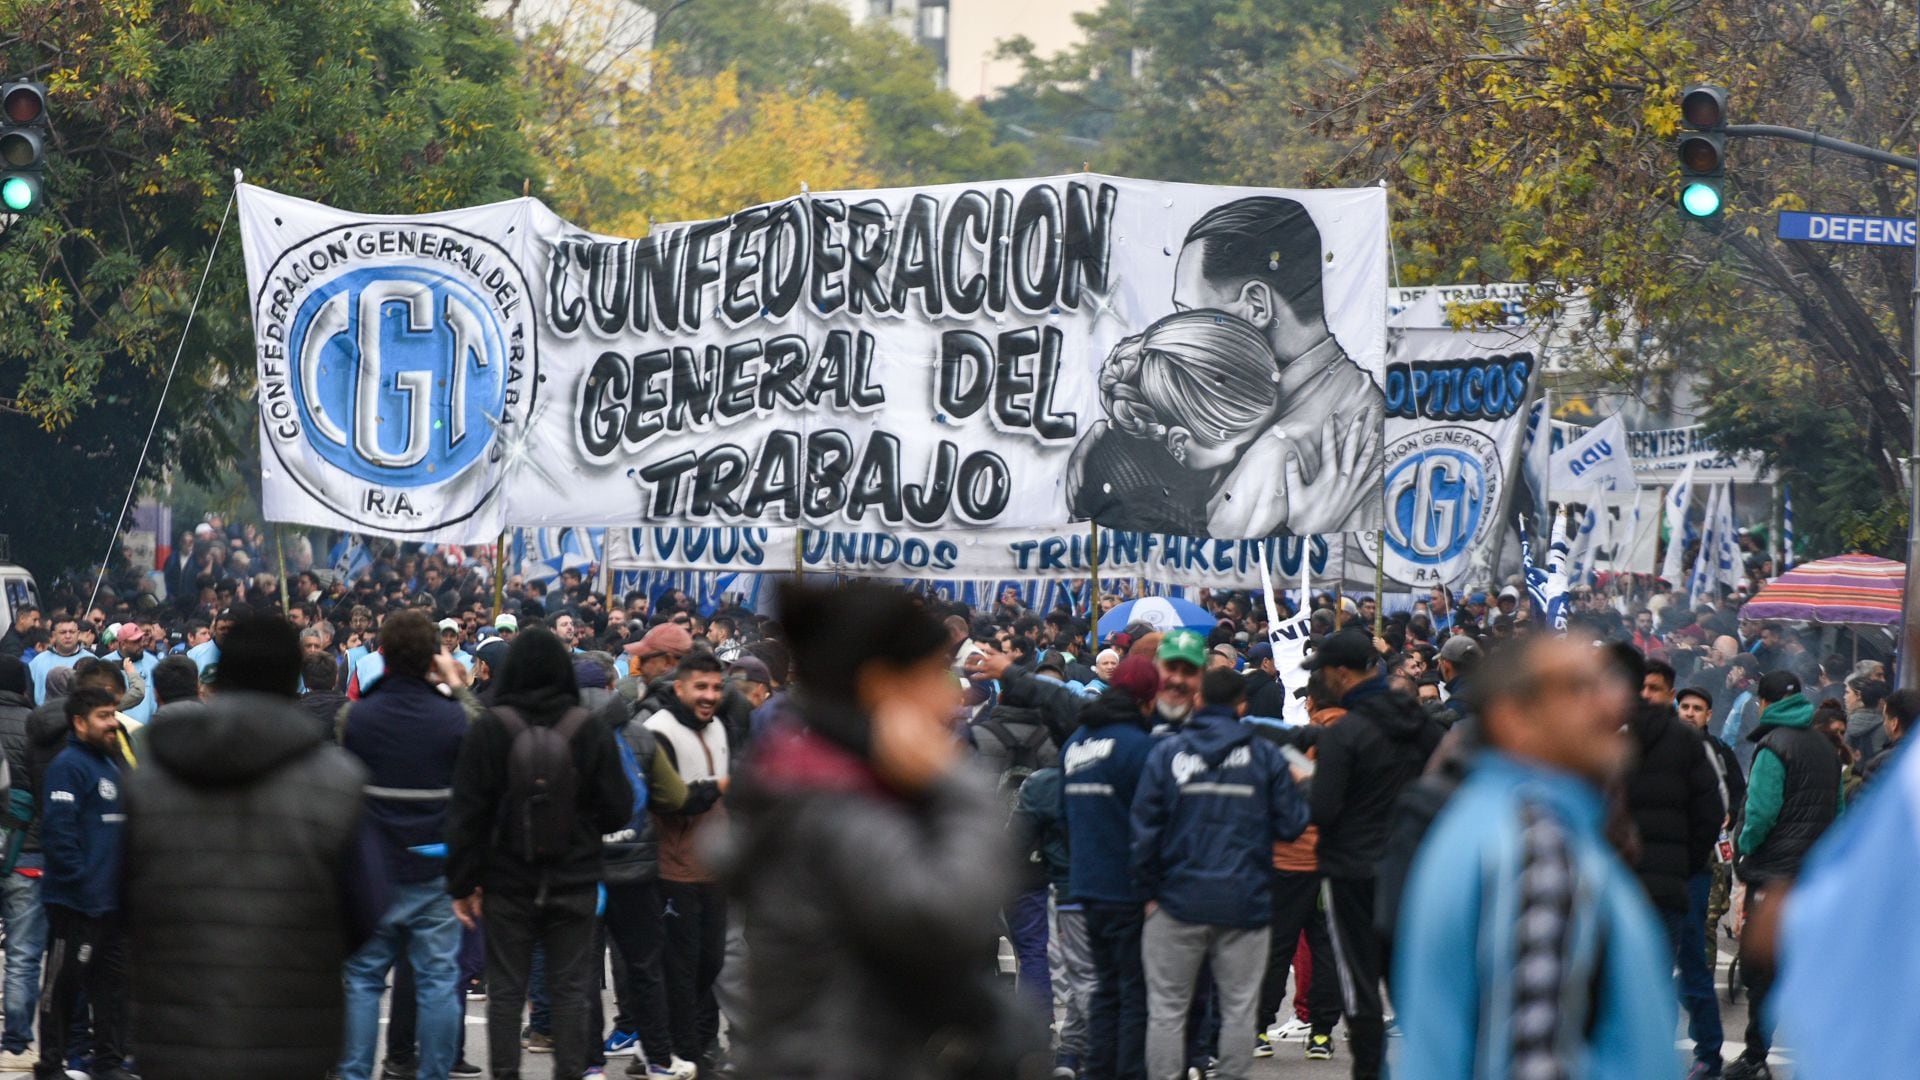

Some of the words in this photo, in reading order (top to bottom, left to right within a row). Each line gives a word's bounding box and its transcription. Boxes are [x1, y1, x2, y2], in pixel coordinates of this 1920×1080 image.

[357, 231, 485, 276] GENERAL
[551, 181, 1117, 333] CONFEDERACION
[1809, 216, 1916, 244] DEFENS
[486, 267, 520, 320] DEL
[1400, 290, 1426, 302] DE
[264, 240, 348, 438] CONFEDERACION
[300, 280, 488, 469] CGT
[490, 322, 525, 463] TRABAO
[580, 330, 885, 456] GENERAL
[940, 325, 1077, 439] DEL
[1384, 360, 1528, 415] OPTICOS
[1423, 431, 1484, 455] GENERAL
[367, 489, 422, 516] R.A.
[639, 429, 1011, 523] TRABAJO
[802, 528, 958, 569] UNIDOS
